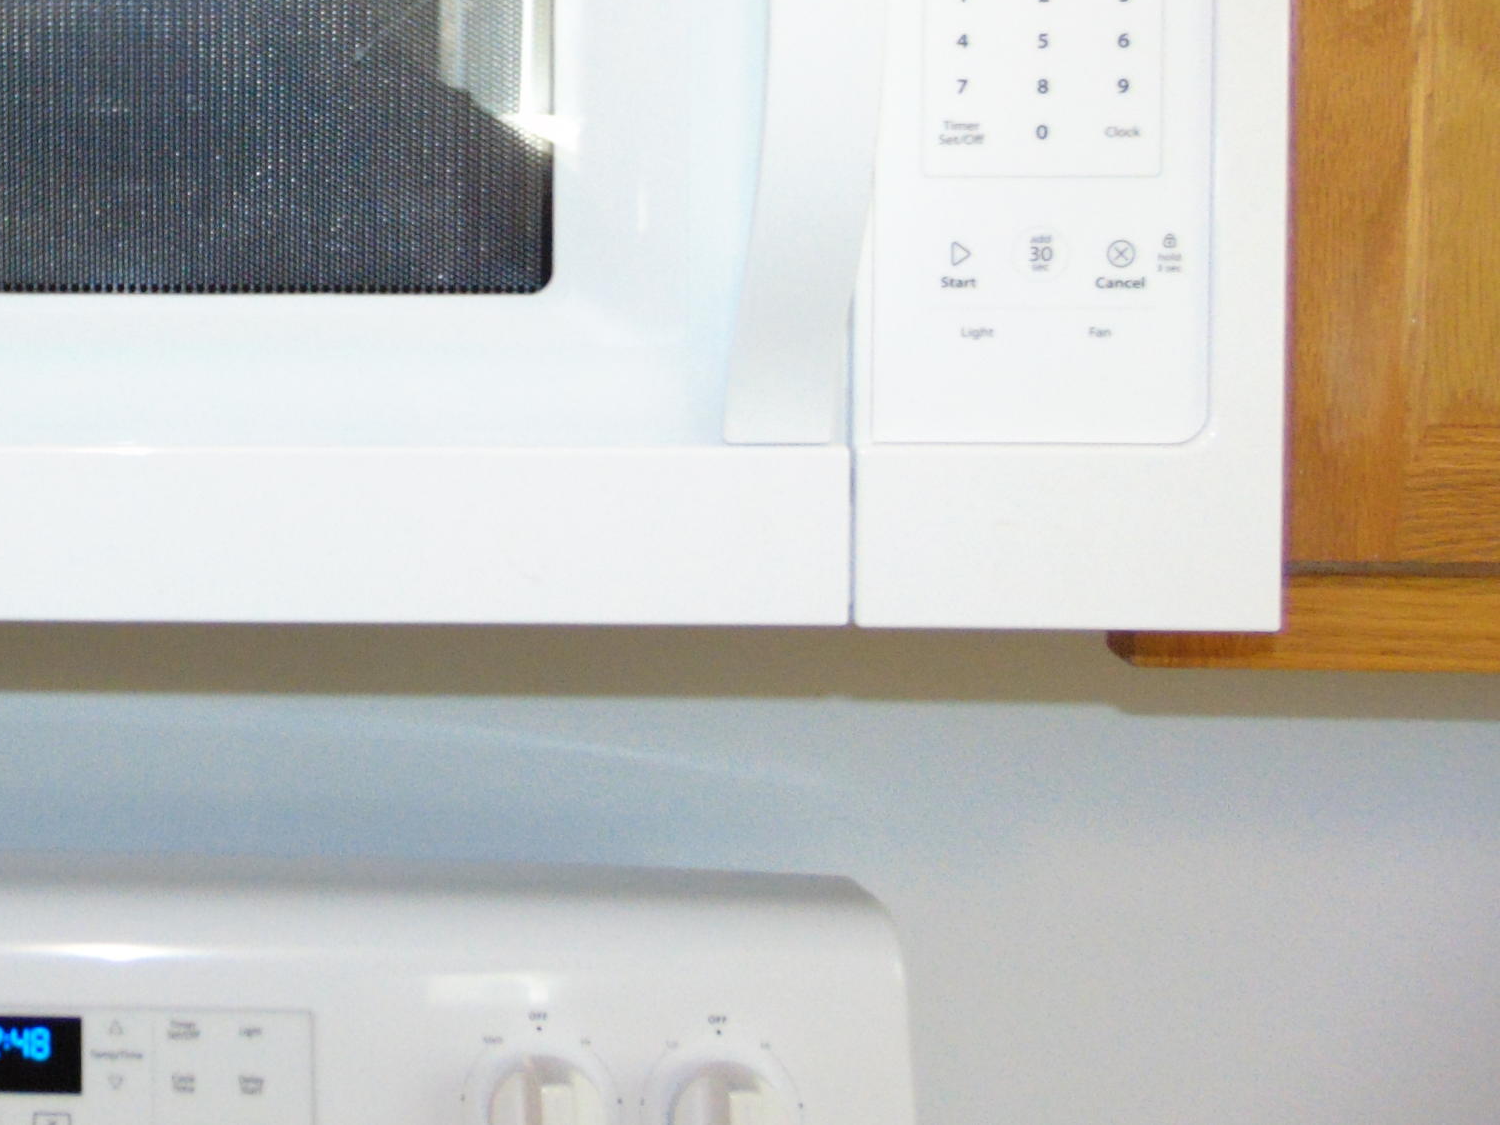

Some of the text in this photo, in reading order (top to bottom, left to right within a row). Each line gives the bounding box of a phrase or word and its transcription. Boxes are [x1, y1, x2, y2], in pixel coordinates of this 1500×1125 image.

[956, 33, 969, 48] 4
[1037, 32, 1049, 49] 5
[1117, 32, 1131, 49] 6
[957, 78, 969, 94] 7
[1036, 78, 1050, 94] 8
[1117, 78, 1130, 94] 9
[943, 120, 981, 132] Timer
[1035, 124, 1049, 141] 0
[1104, 126, 1142, 139] Clock
[1029, 246, 1054, 263] 30
[940, 276, 977, 289] Start
[1095, 276, 1146, 290] Cancel
[960, 327, 995, 341] Light
[1088, 326, 1113, 339] Fan
